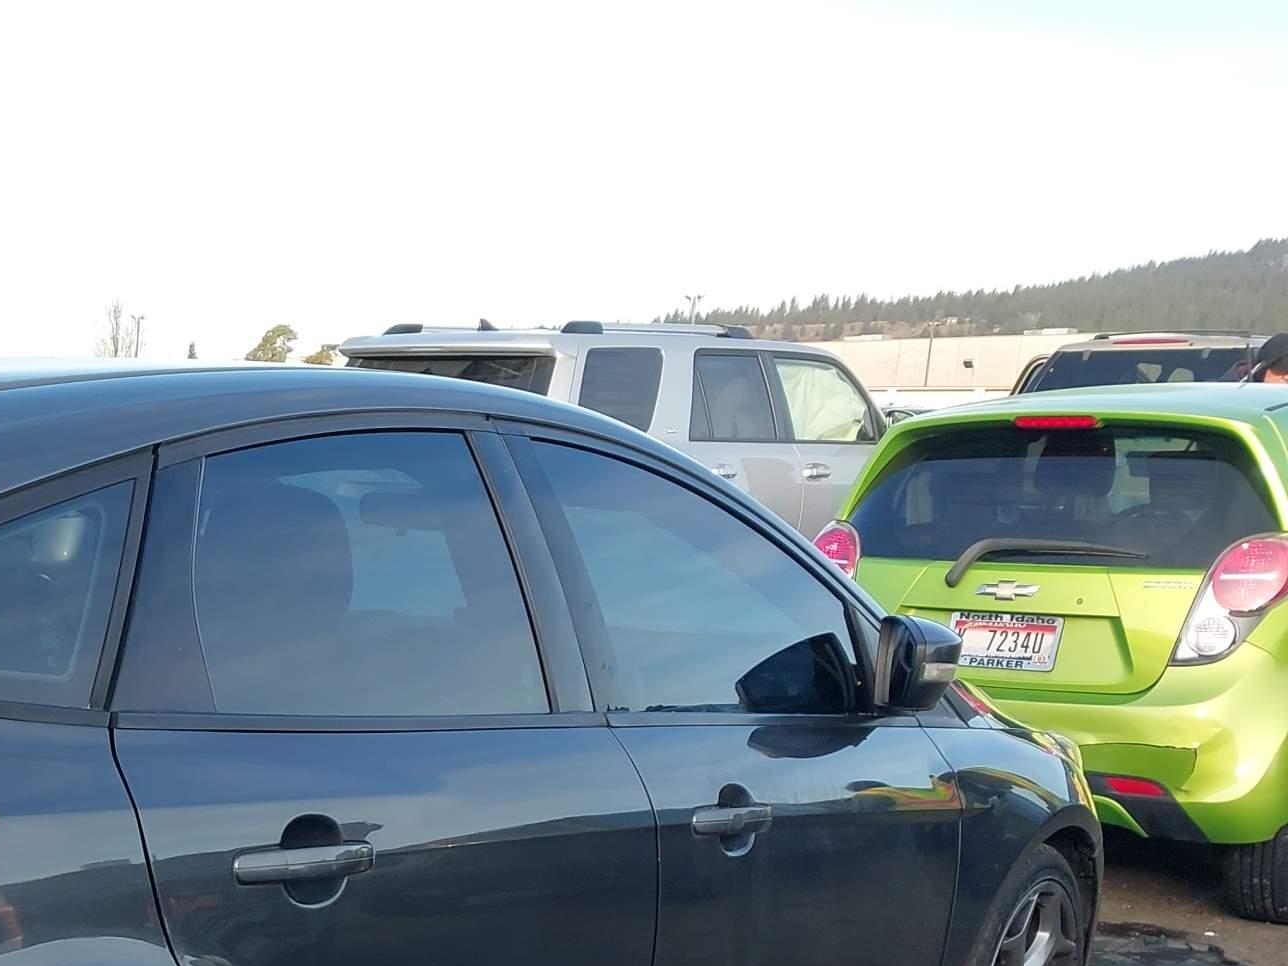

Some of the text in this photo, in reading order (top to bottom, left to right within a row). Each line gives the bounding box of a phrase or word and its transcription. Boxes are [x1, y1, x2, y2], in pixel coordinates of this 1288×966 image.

[959, 612, 1003, 621] North
[1010, 614, 1056, 625] Idaho
[986, 629, 1045, 654] 7234U
[969, 657, 1024, 669] PARKER
